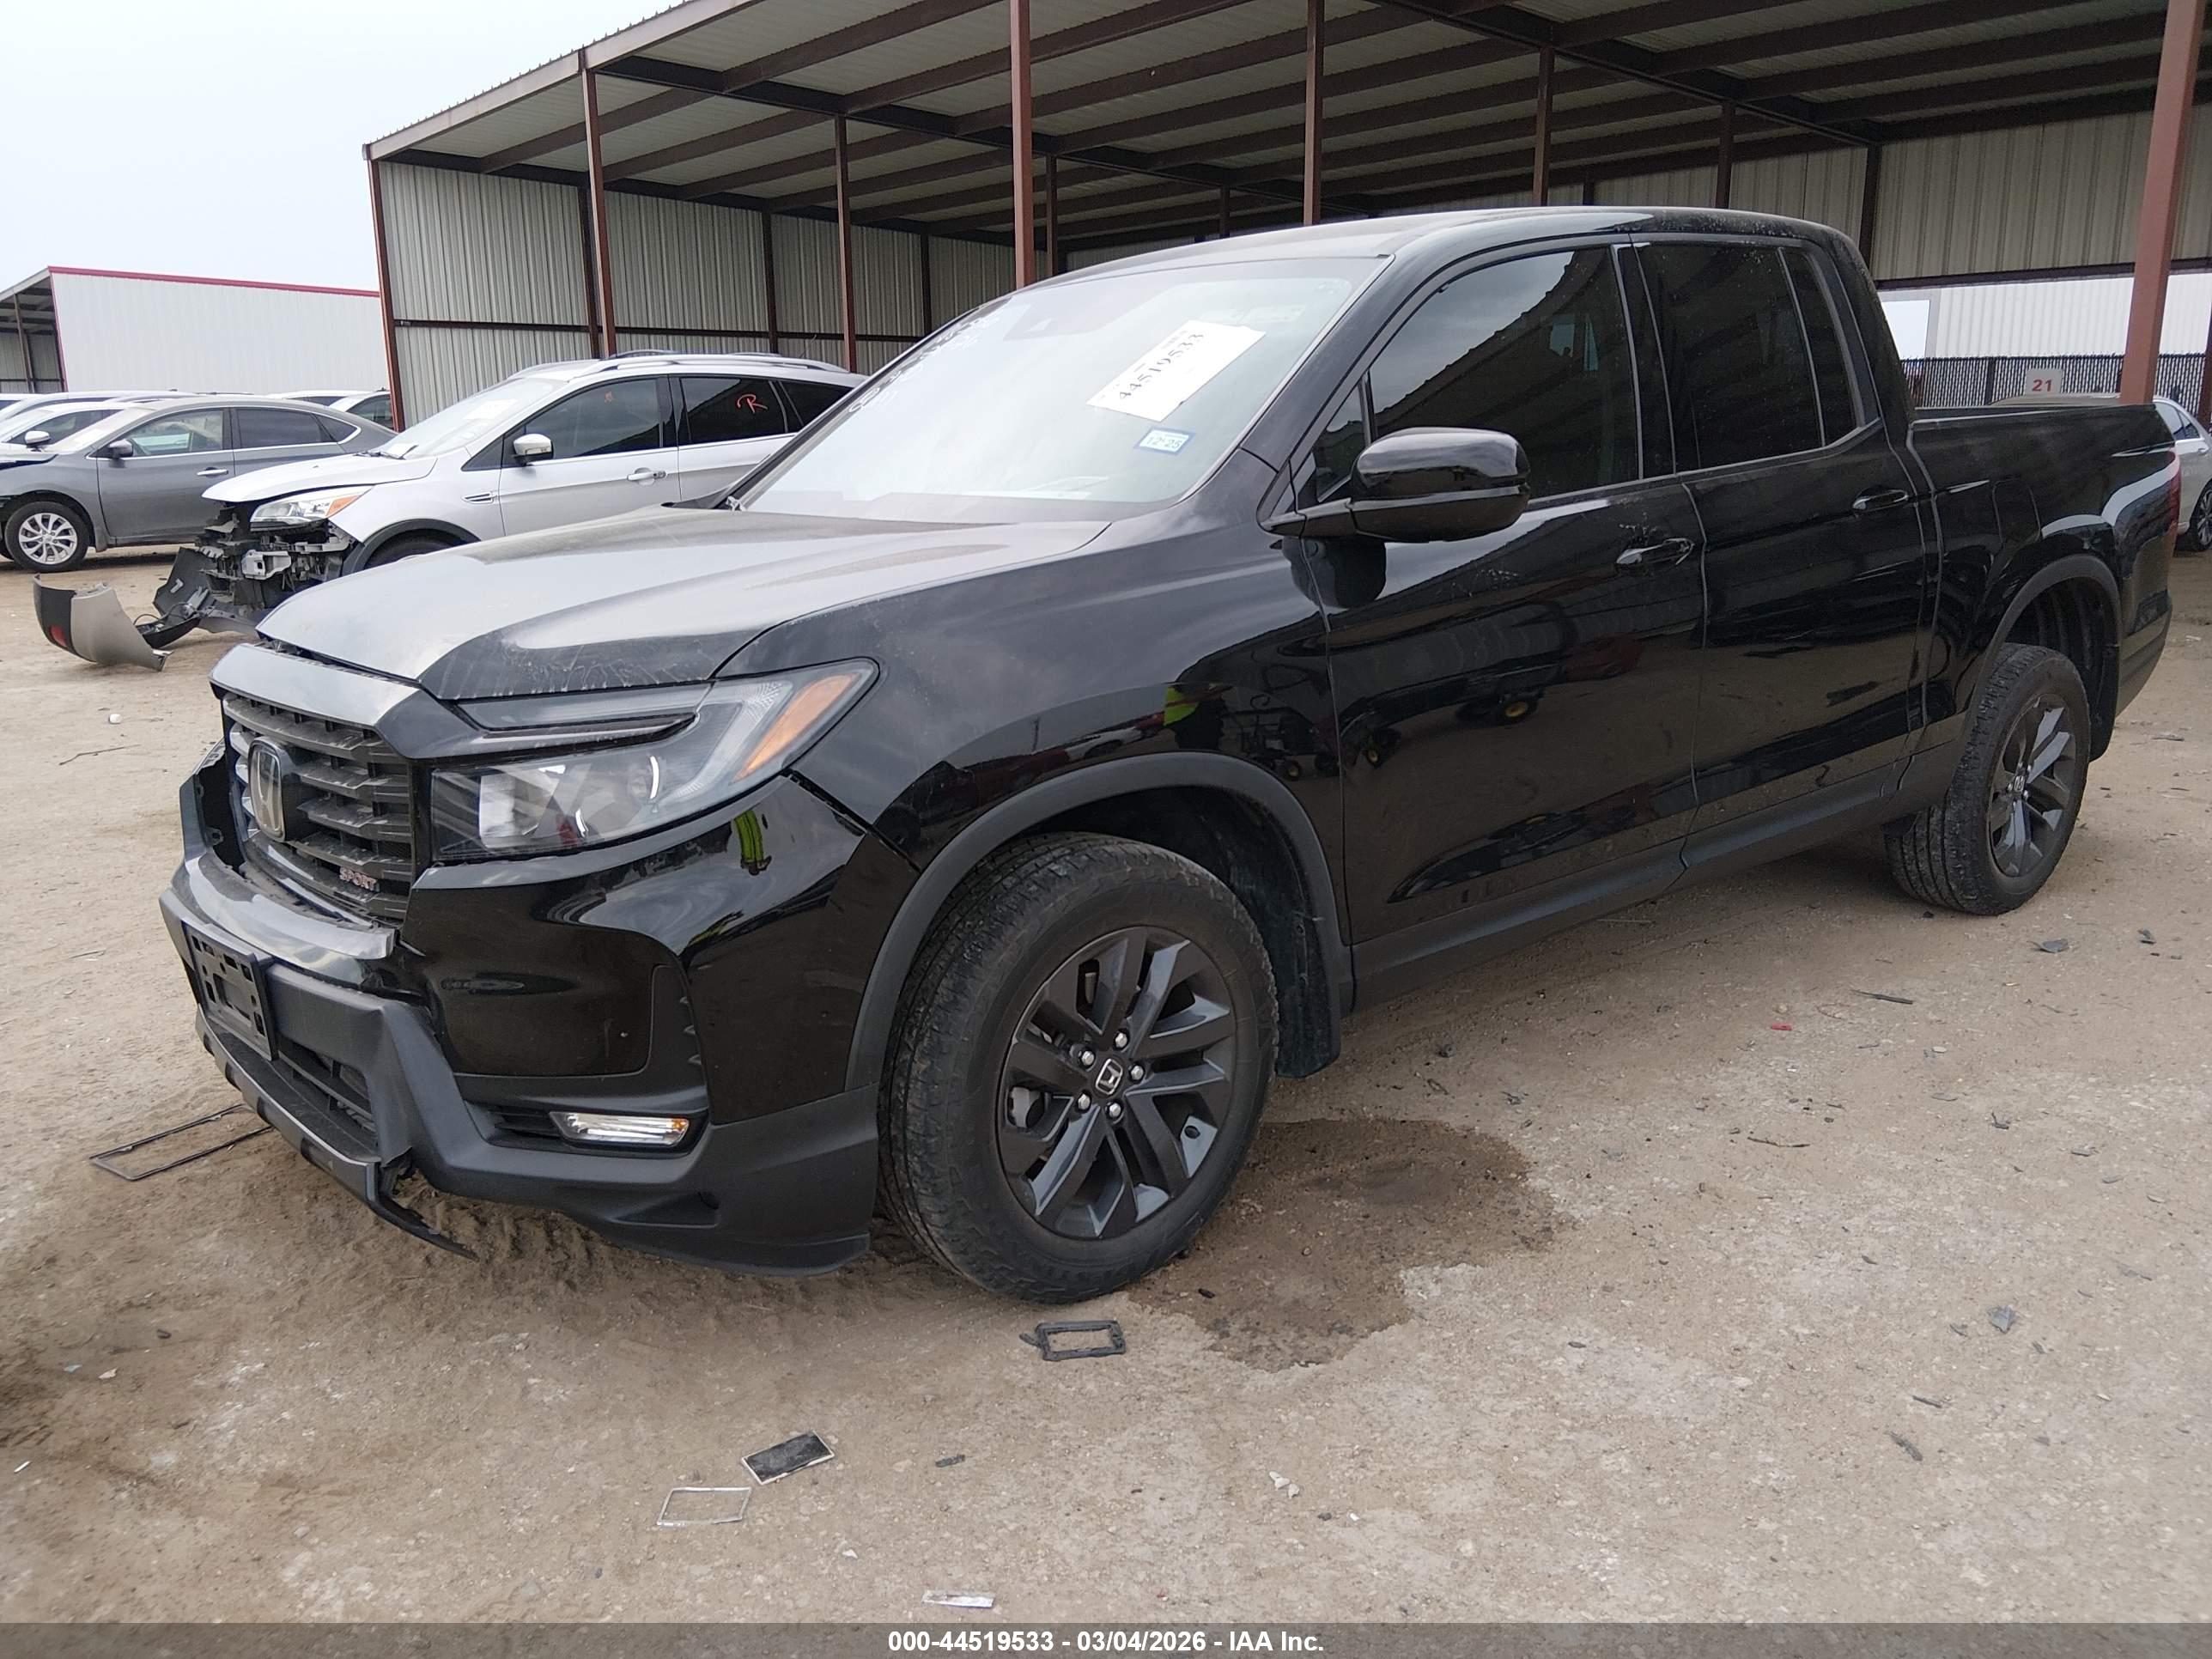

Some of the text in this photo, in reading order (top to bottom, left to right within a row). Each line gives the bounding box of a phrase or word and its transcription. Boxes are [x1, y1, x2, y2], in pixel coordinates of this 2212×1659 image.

[1119, 332, 1204, 399] 44519533
[2032, 379, 2052, 392] 21
[737, 393, 769, 414] R
[339, 866, 377, 891] SPORT
